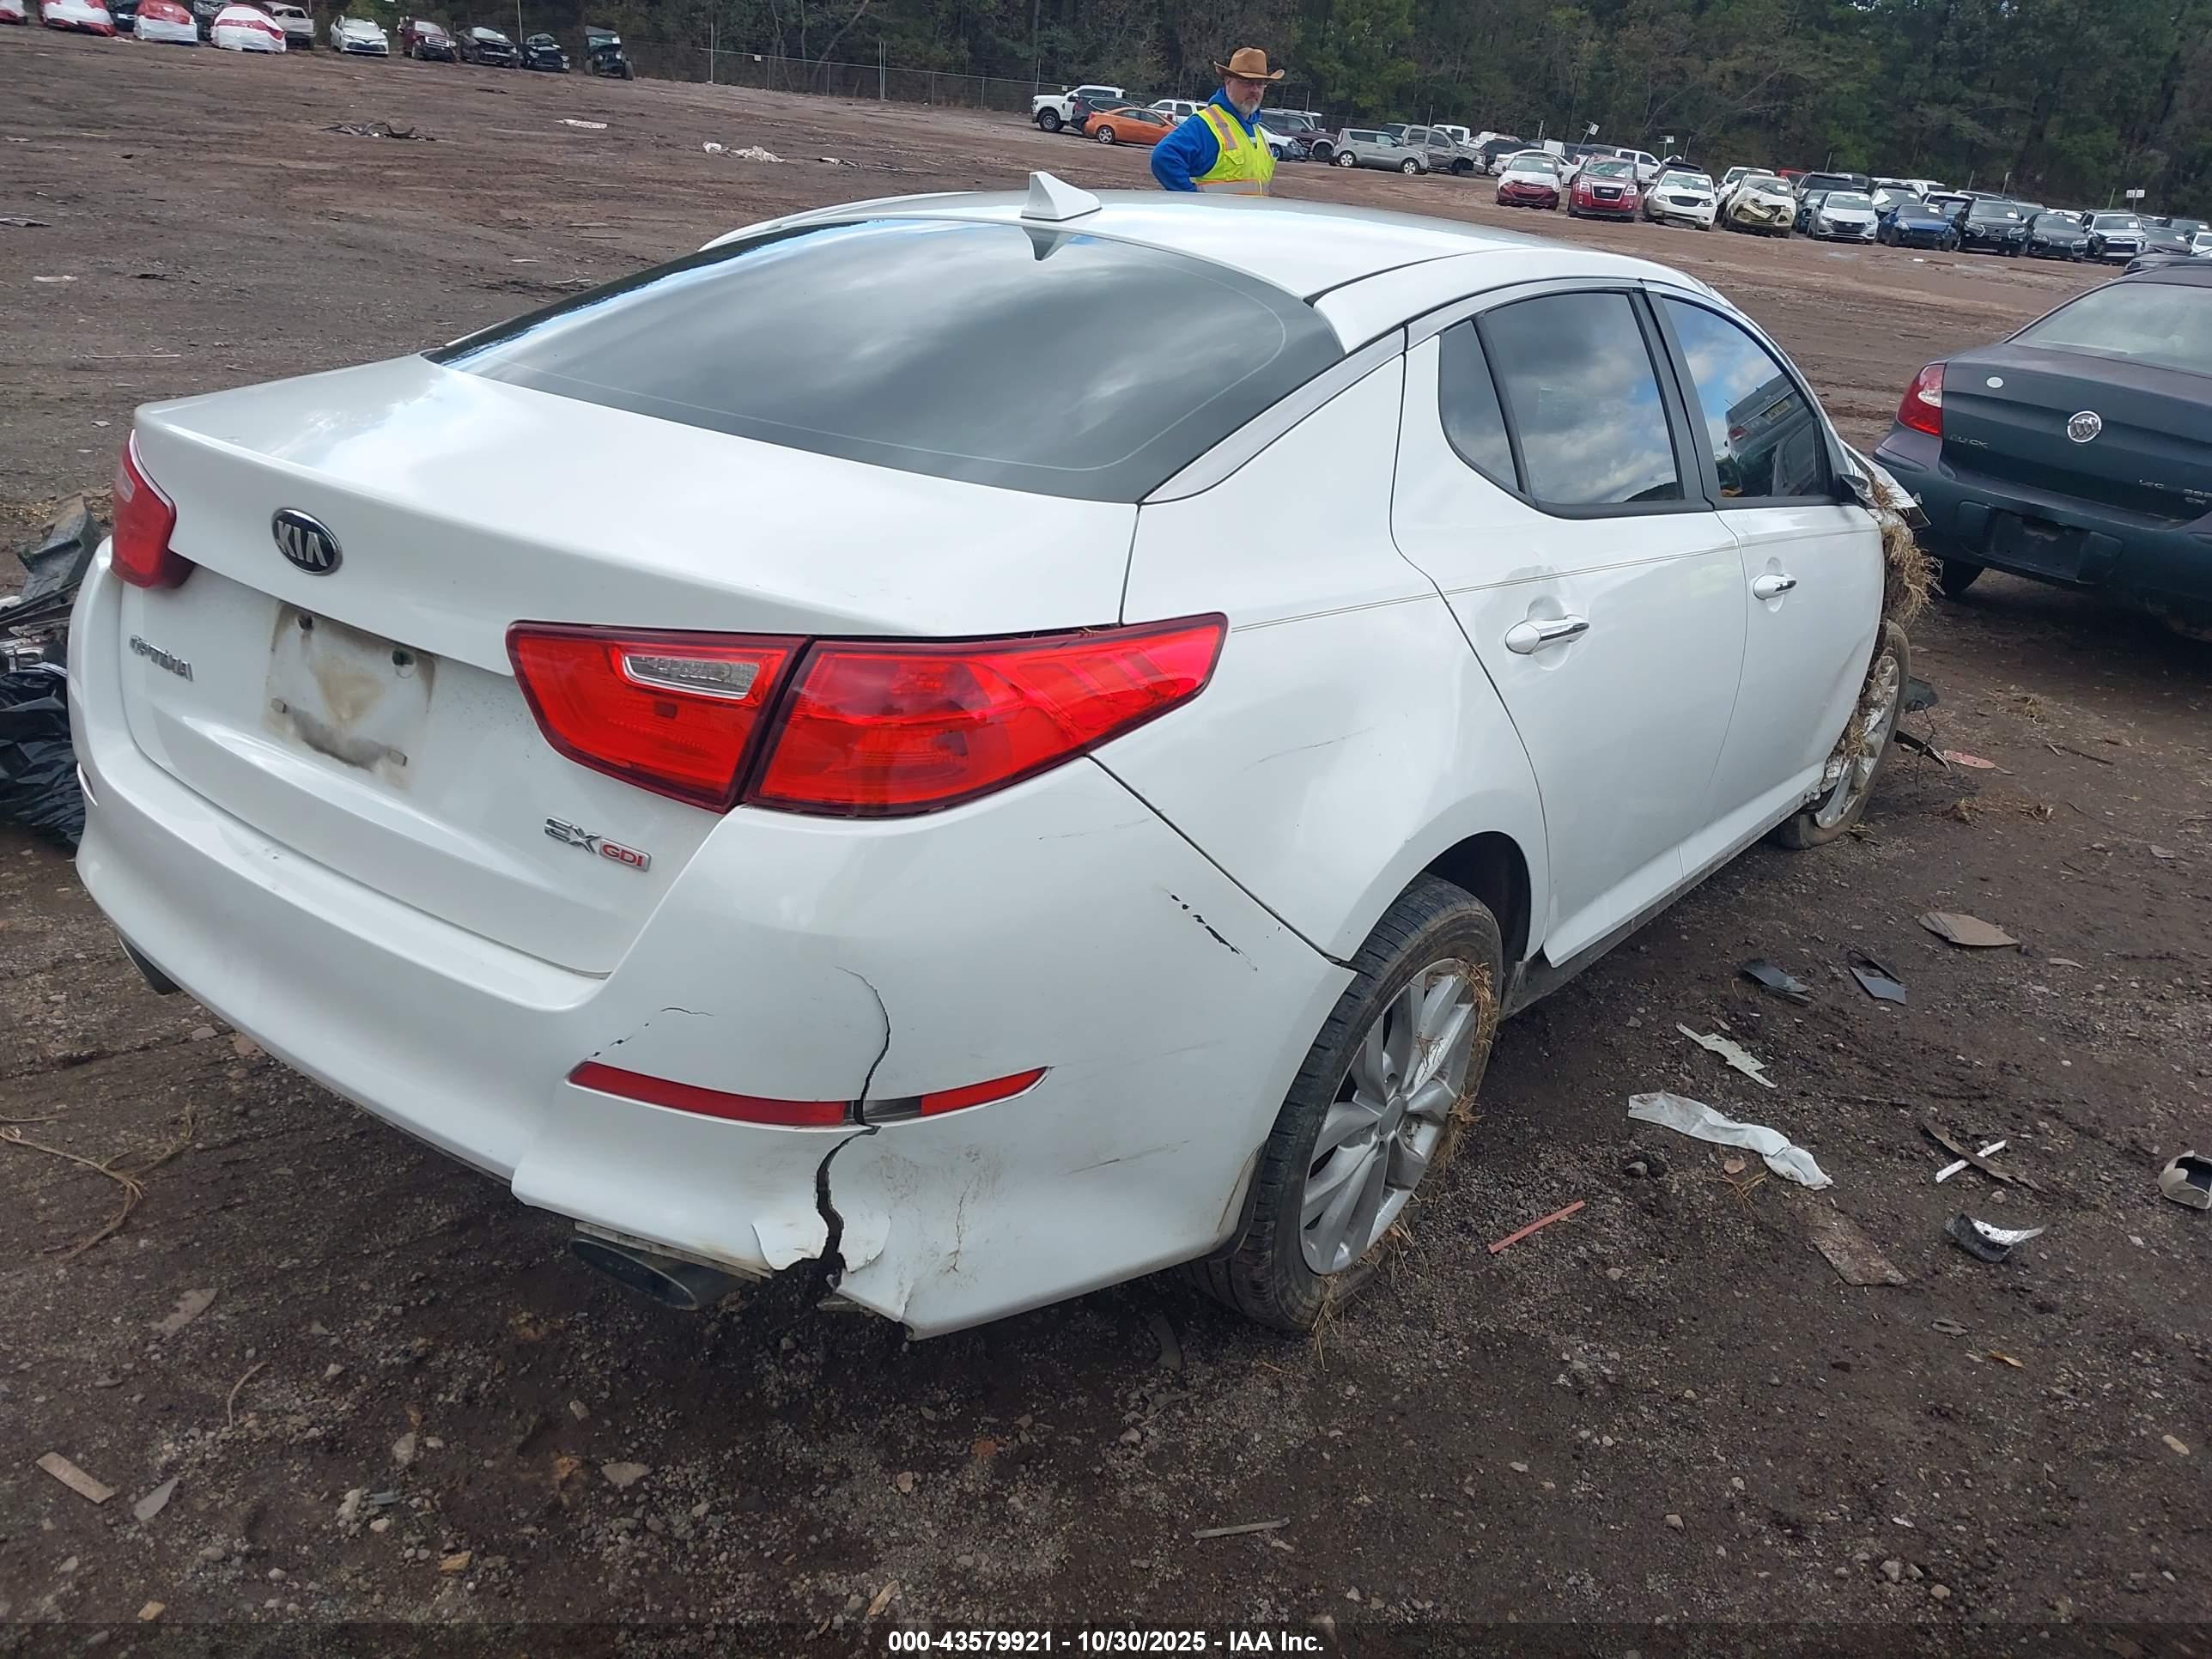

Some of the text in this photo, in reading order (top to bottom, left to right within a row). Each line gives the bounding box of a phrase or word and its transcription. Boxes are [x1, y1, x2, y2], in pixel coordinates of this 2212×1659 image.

[276, 518, 330, 568] KIA
[544, 816, 645, 868] EX GDI
